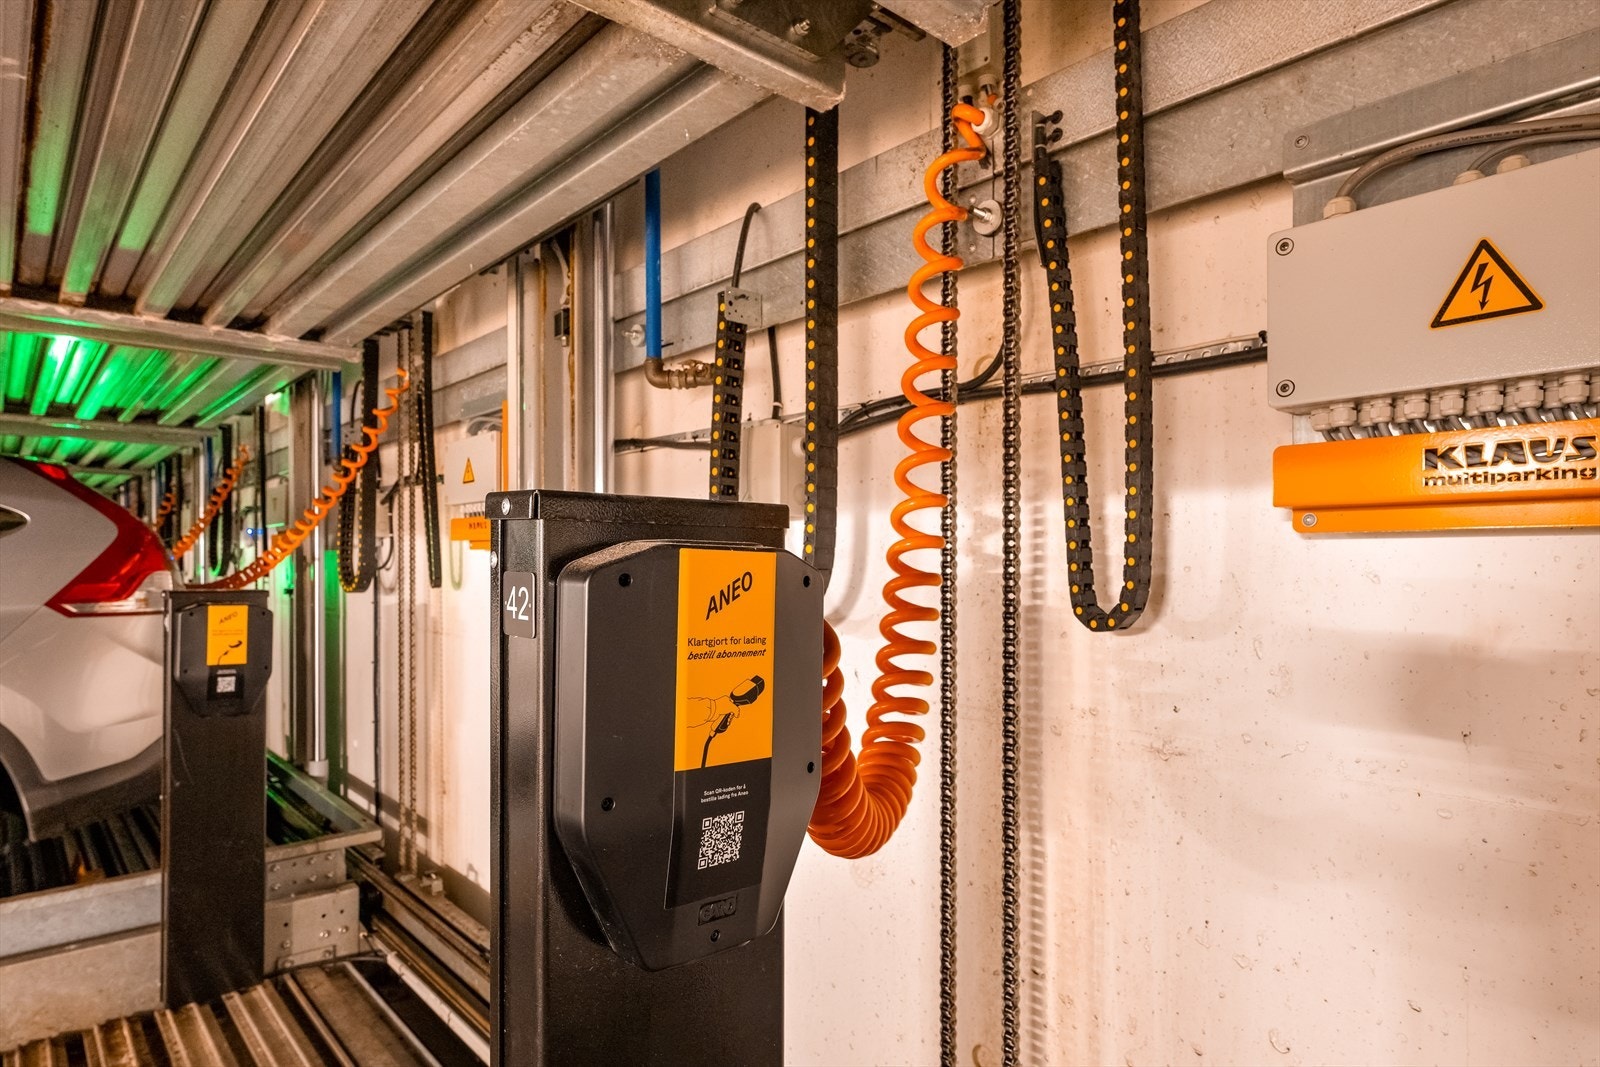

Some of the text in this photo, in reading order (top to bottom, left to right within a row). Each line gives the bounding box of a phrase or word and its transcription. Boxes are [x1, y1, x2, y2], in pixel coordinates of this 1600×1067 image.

[1423, 435, 1599, 471] KLAUS
[1423, 466, 1598, 487] multiparking
[506, 585, 530, 621] 42
[705, 571, 753, 620] ANEO
[687, 635, 767, 648] Klartgjort for lading
[687, 648, 767, 661] bestill abonnement
[715, 786, 736, 794] QR-koden
